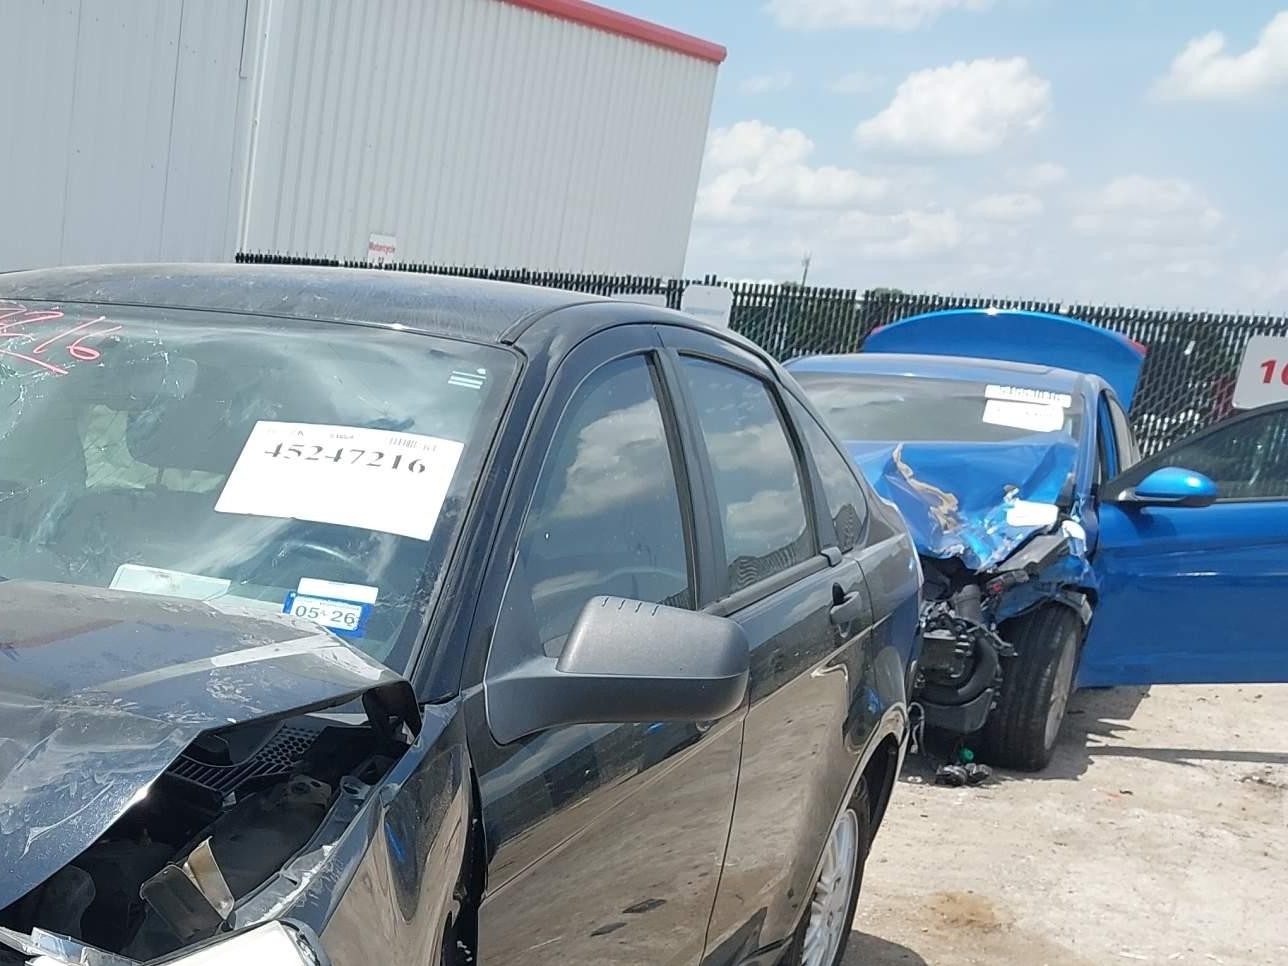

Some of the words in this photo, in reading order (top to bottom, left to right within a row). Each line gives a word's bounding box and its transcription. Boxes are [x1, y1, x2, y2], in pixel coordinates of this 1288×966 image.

[264, 442, 426, 474] 45247216
[295, 605, 321, 619] 05
[329, 609, 357, 626] 26
